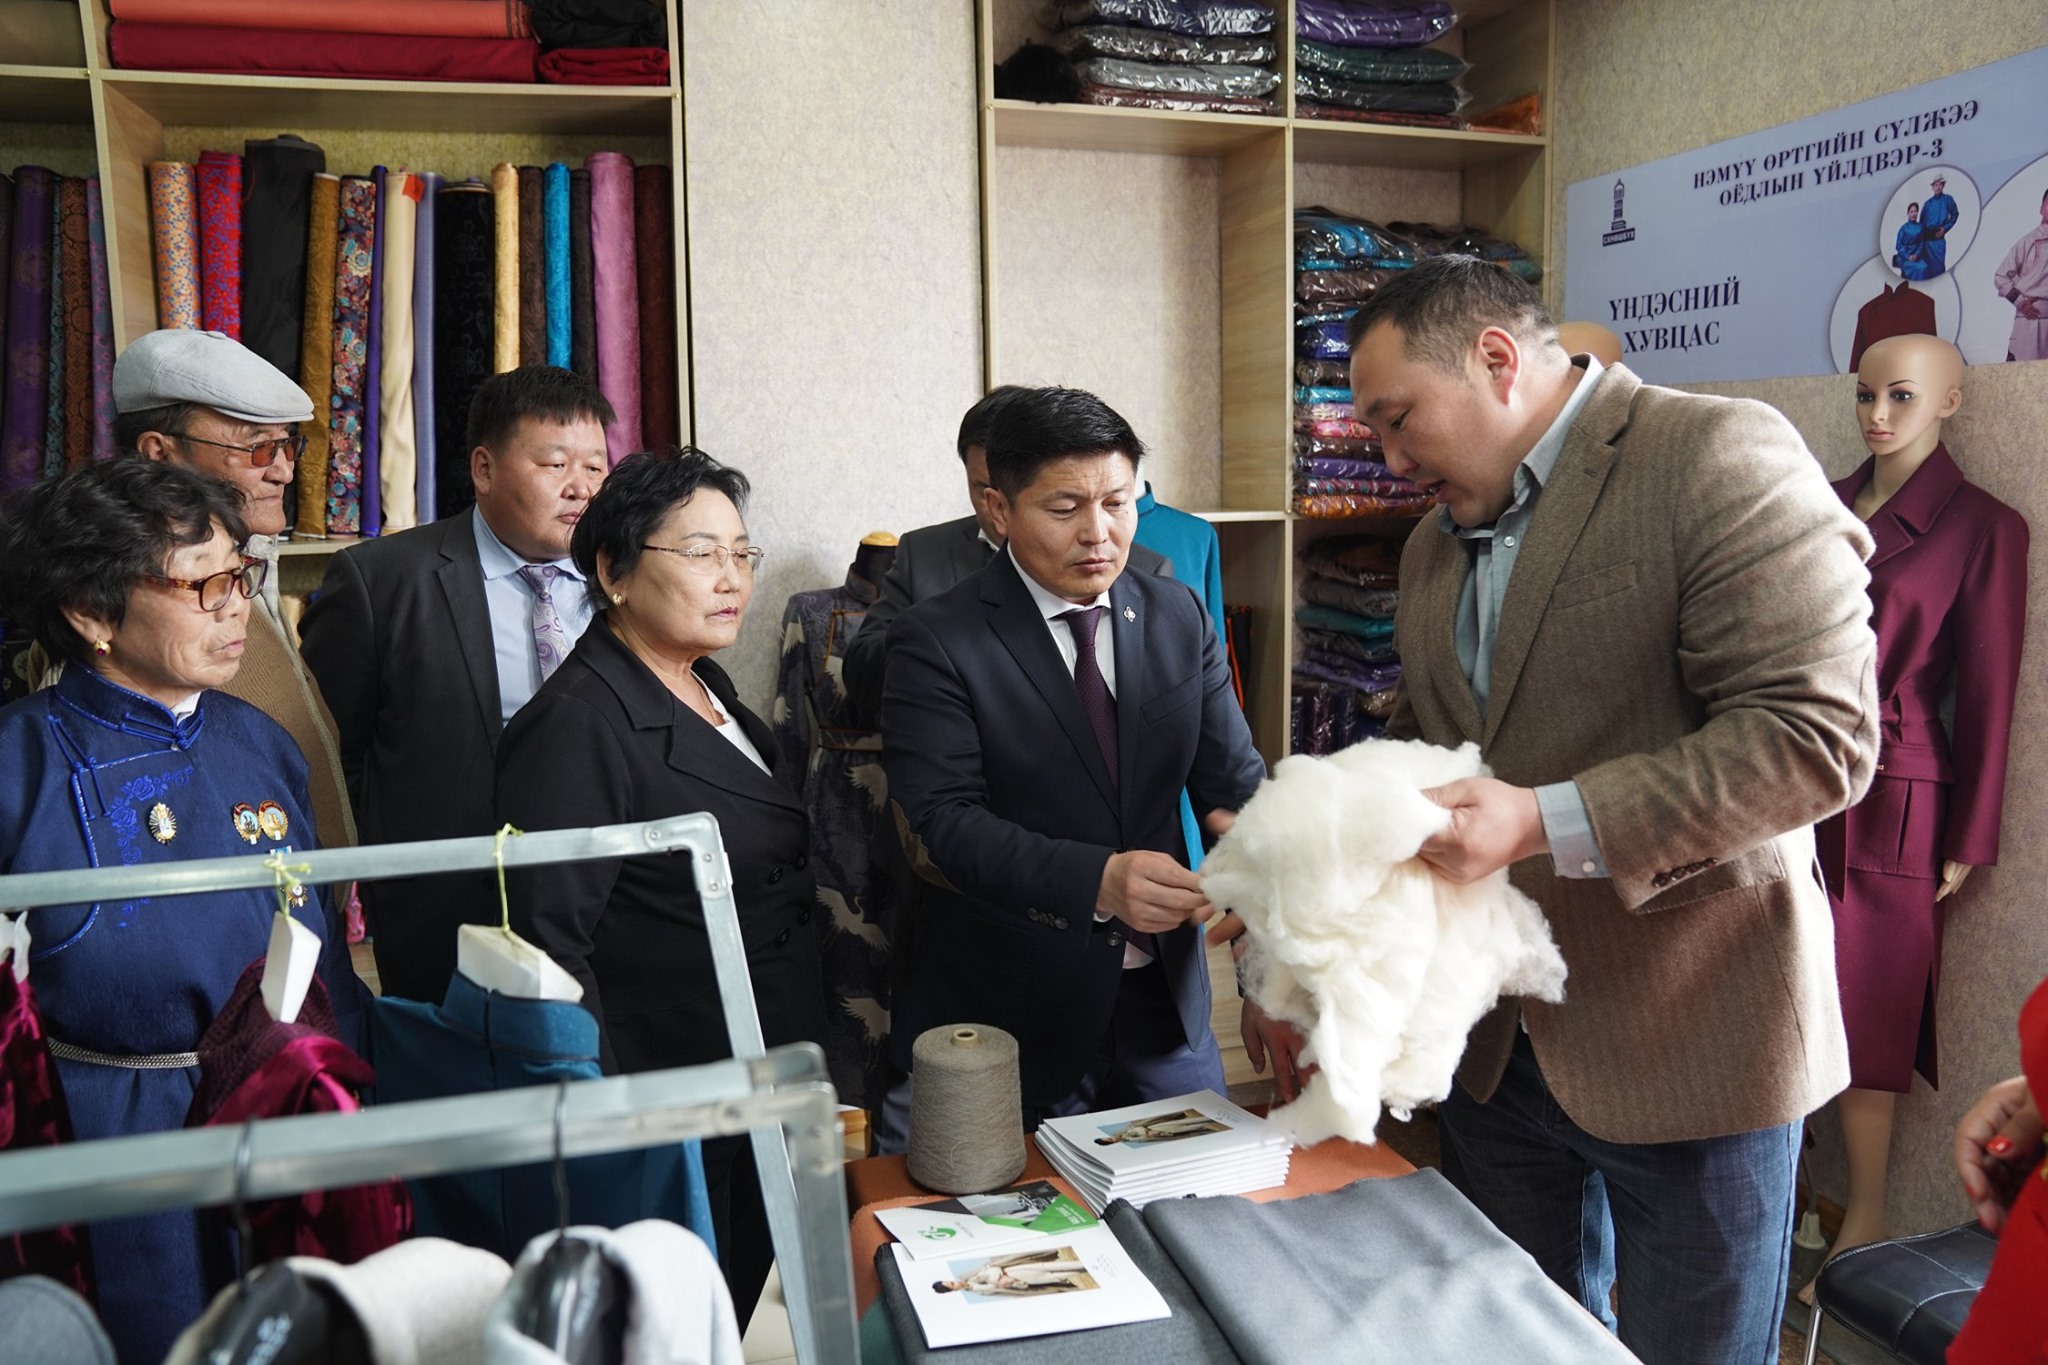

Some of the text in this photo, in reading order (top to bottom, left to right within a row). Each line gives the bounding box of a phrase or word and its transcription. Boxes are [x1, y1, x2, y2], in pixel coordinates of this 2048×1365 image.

[1693, 100, 1979, 189] НЭМҮҮ ӨРТГИЙН СҮЛЖЭЭ
[1719, 138, 1943, 207] ОЁДЛЫН ҮЙЛДВЭР-3
[1609, 275, 1741, 322] ҮНДЭСНИЙ
[1624, 321, 1720, 354] ХУВЦАС
